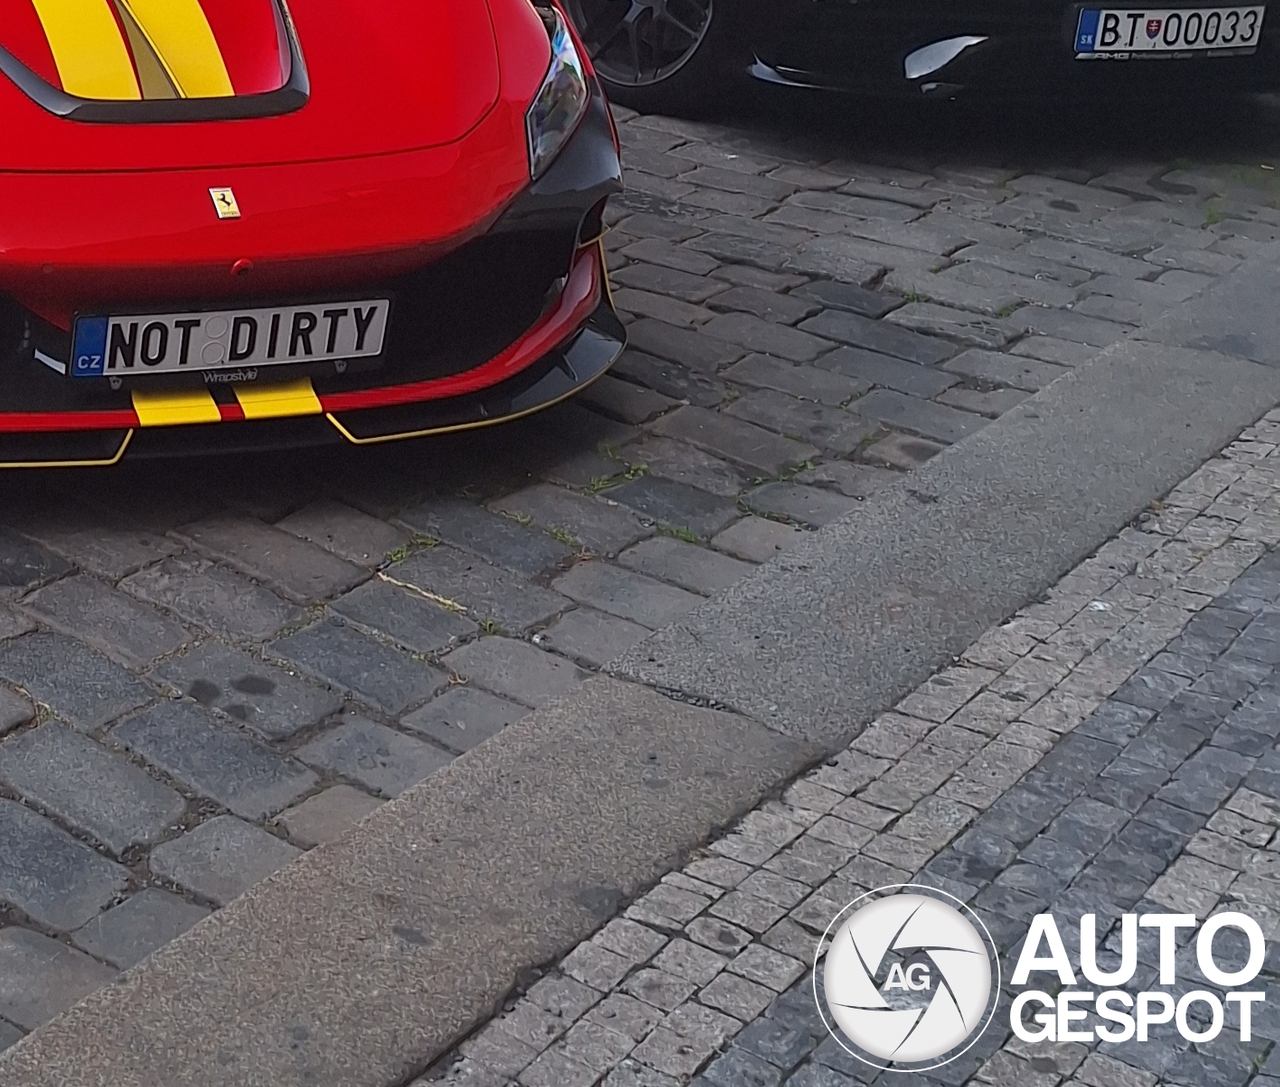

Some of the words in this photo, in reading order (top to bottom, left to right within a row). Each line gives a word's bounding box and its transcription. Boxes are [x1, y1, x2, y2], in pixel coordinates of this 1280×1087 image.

[1100, 13, 1145, 47] BT
[1080, 35, 1093, 45] SK
[1093, 52, 1130, 60] AMG
[107, 319, 201, 369] NOT
[228, 306, 378, 362] DIRTY
[78, 355, 101, 370] CZ
[201, 367, 258, 383] Wrapstyle
